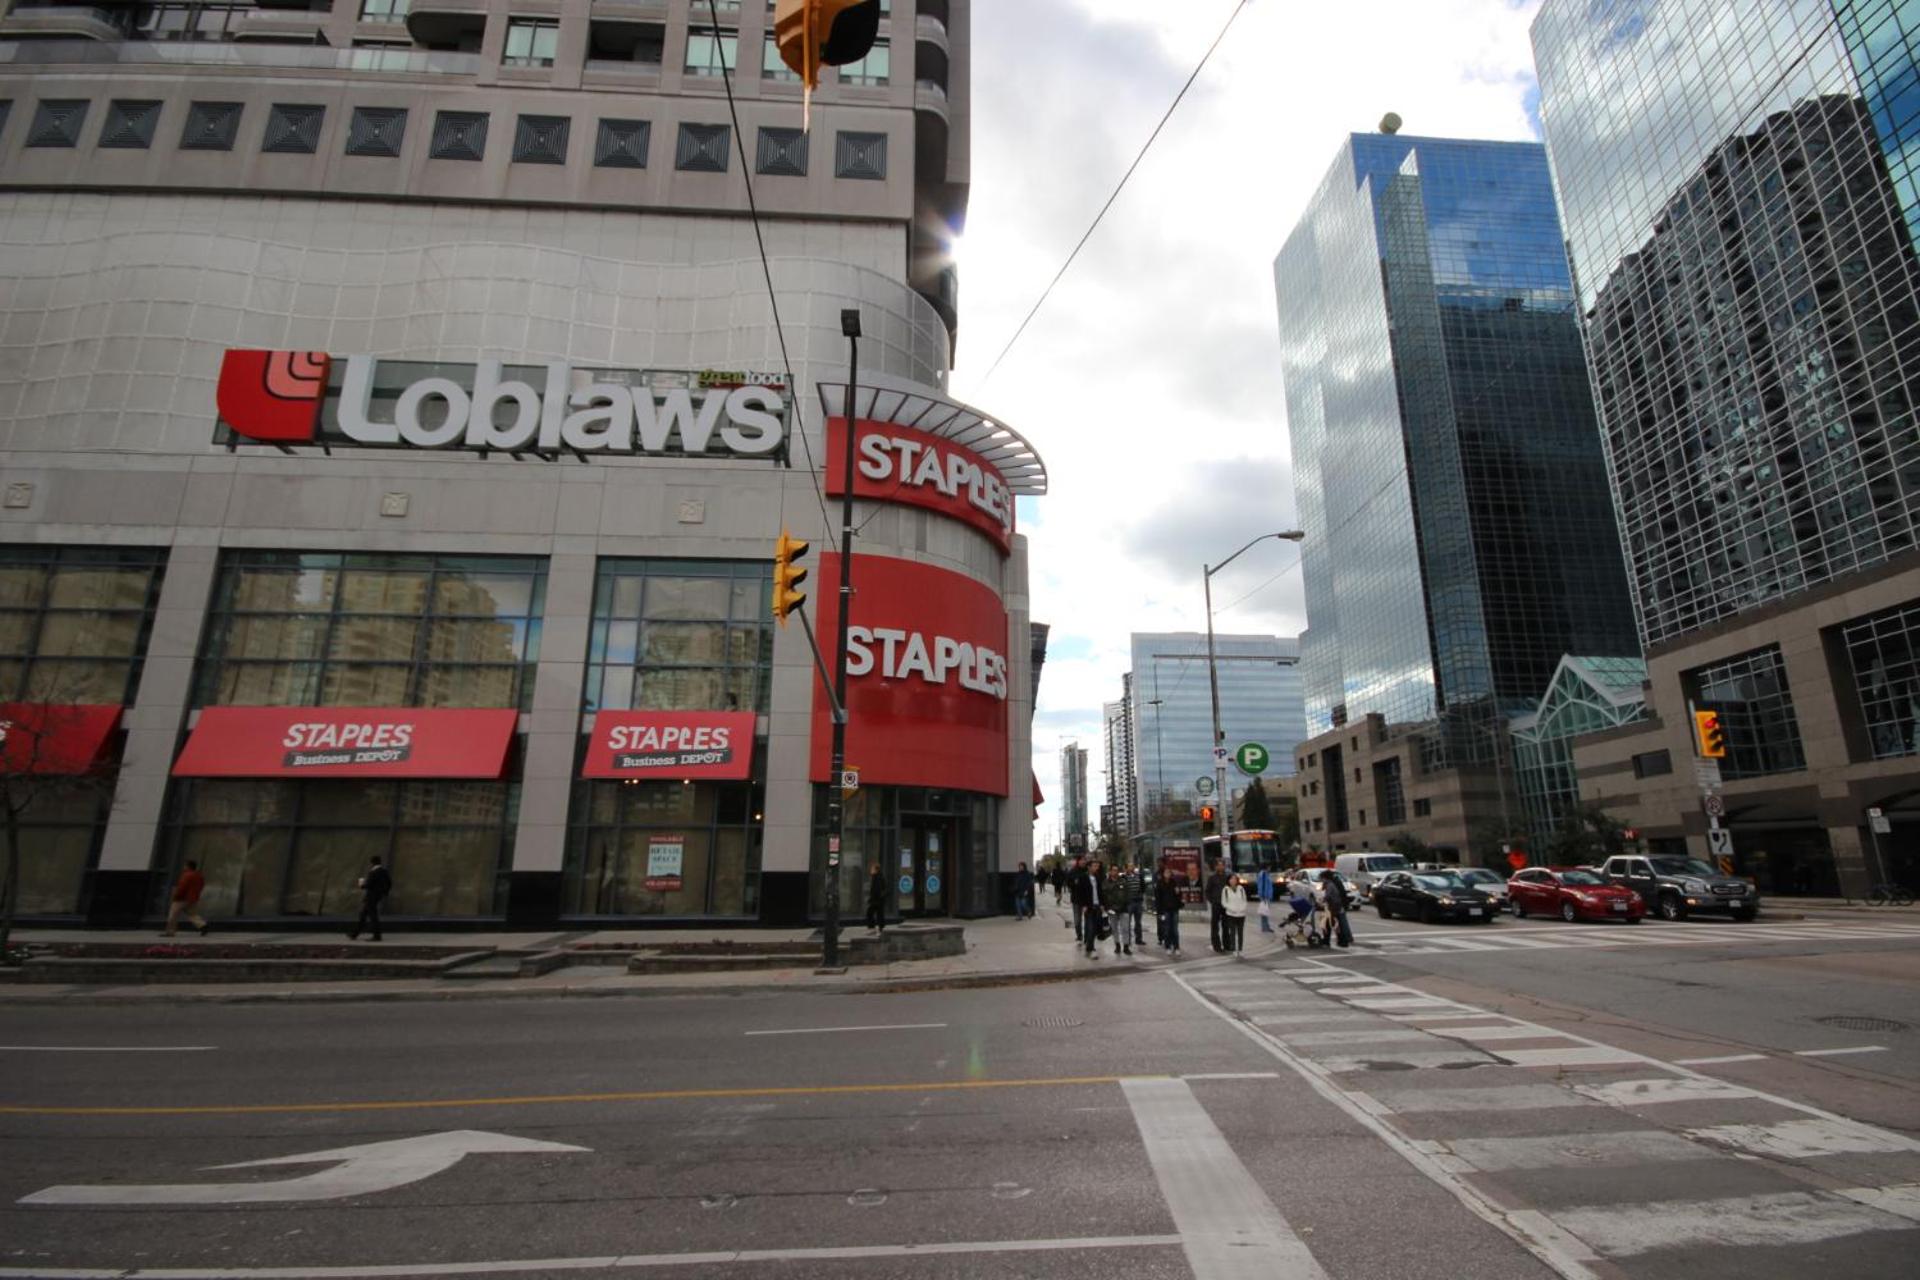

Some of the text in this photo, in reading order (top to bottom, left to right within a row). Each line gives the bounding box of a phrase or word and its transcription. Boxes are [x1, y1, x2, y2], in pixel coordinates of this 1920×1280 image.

[337, 354, 784, 453] Loblaws
[858, 434, 1011, 532] STAPLES
[846, 625, 1007, 700] STAPLES
[282, 723, 413, 748] STAPLES
[608, 726, 729, 750] STAPLES
[293, 750, 401, 766] Business DEPOT
[623, 753, 723, 768] Business DEPOT
[1244, 748, 1262, 765] P
